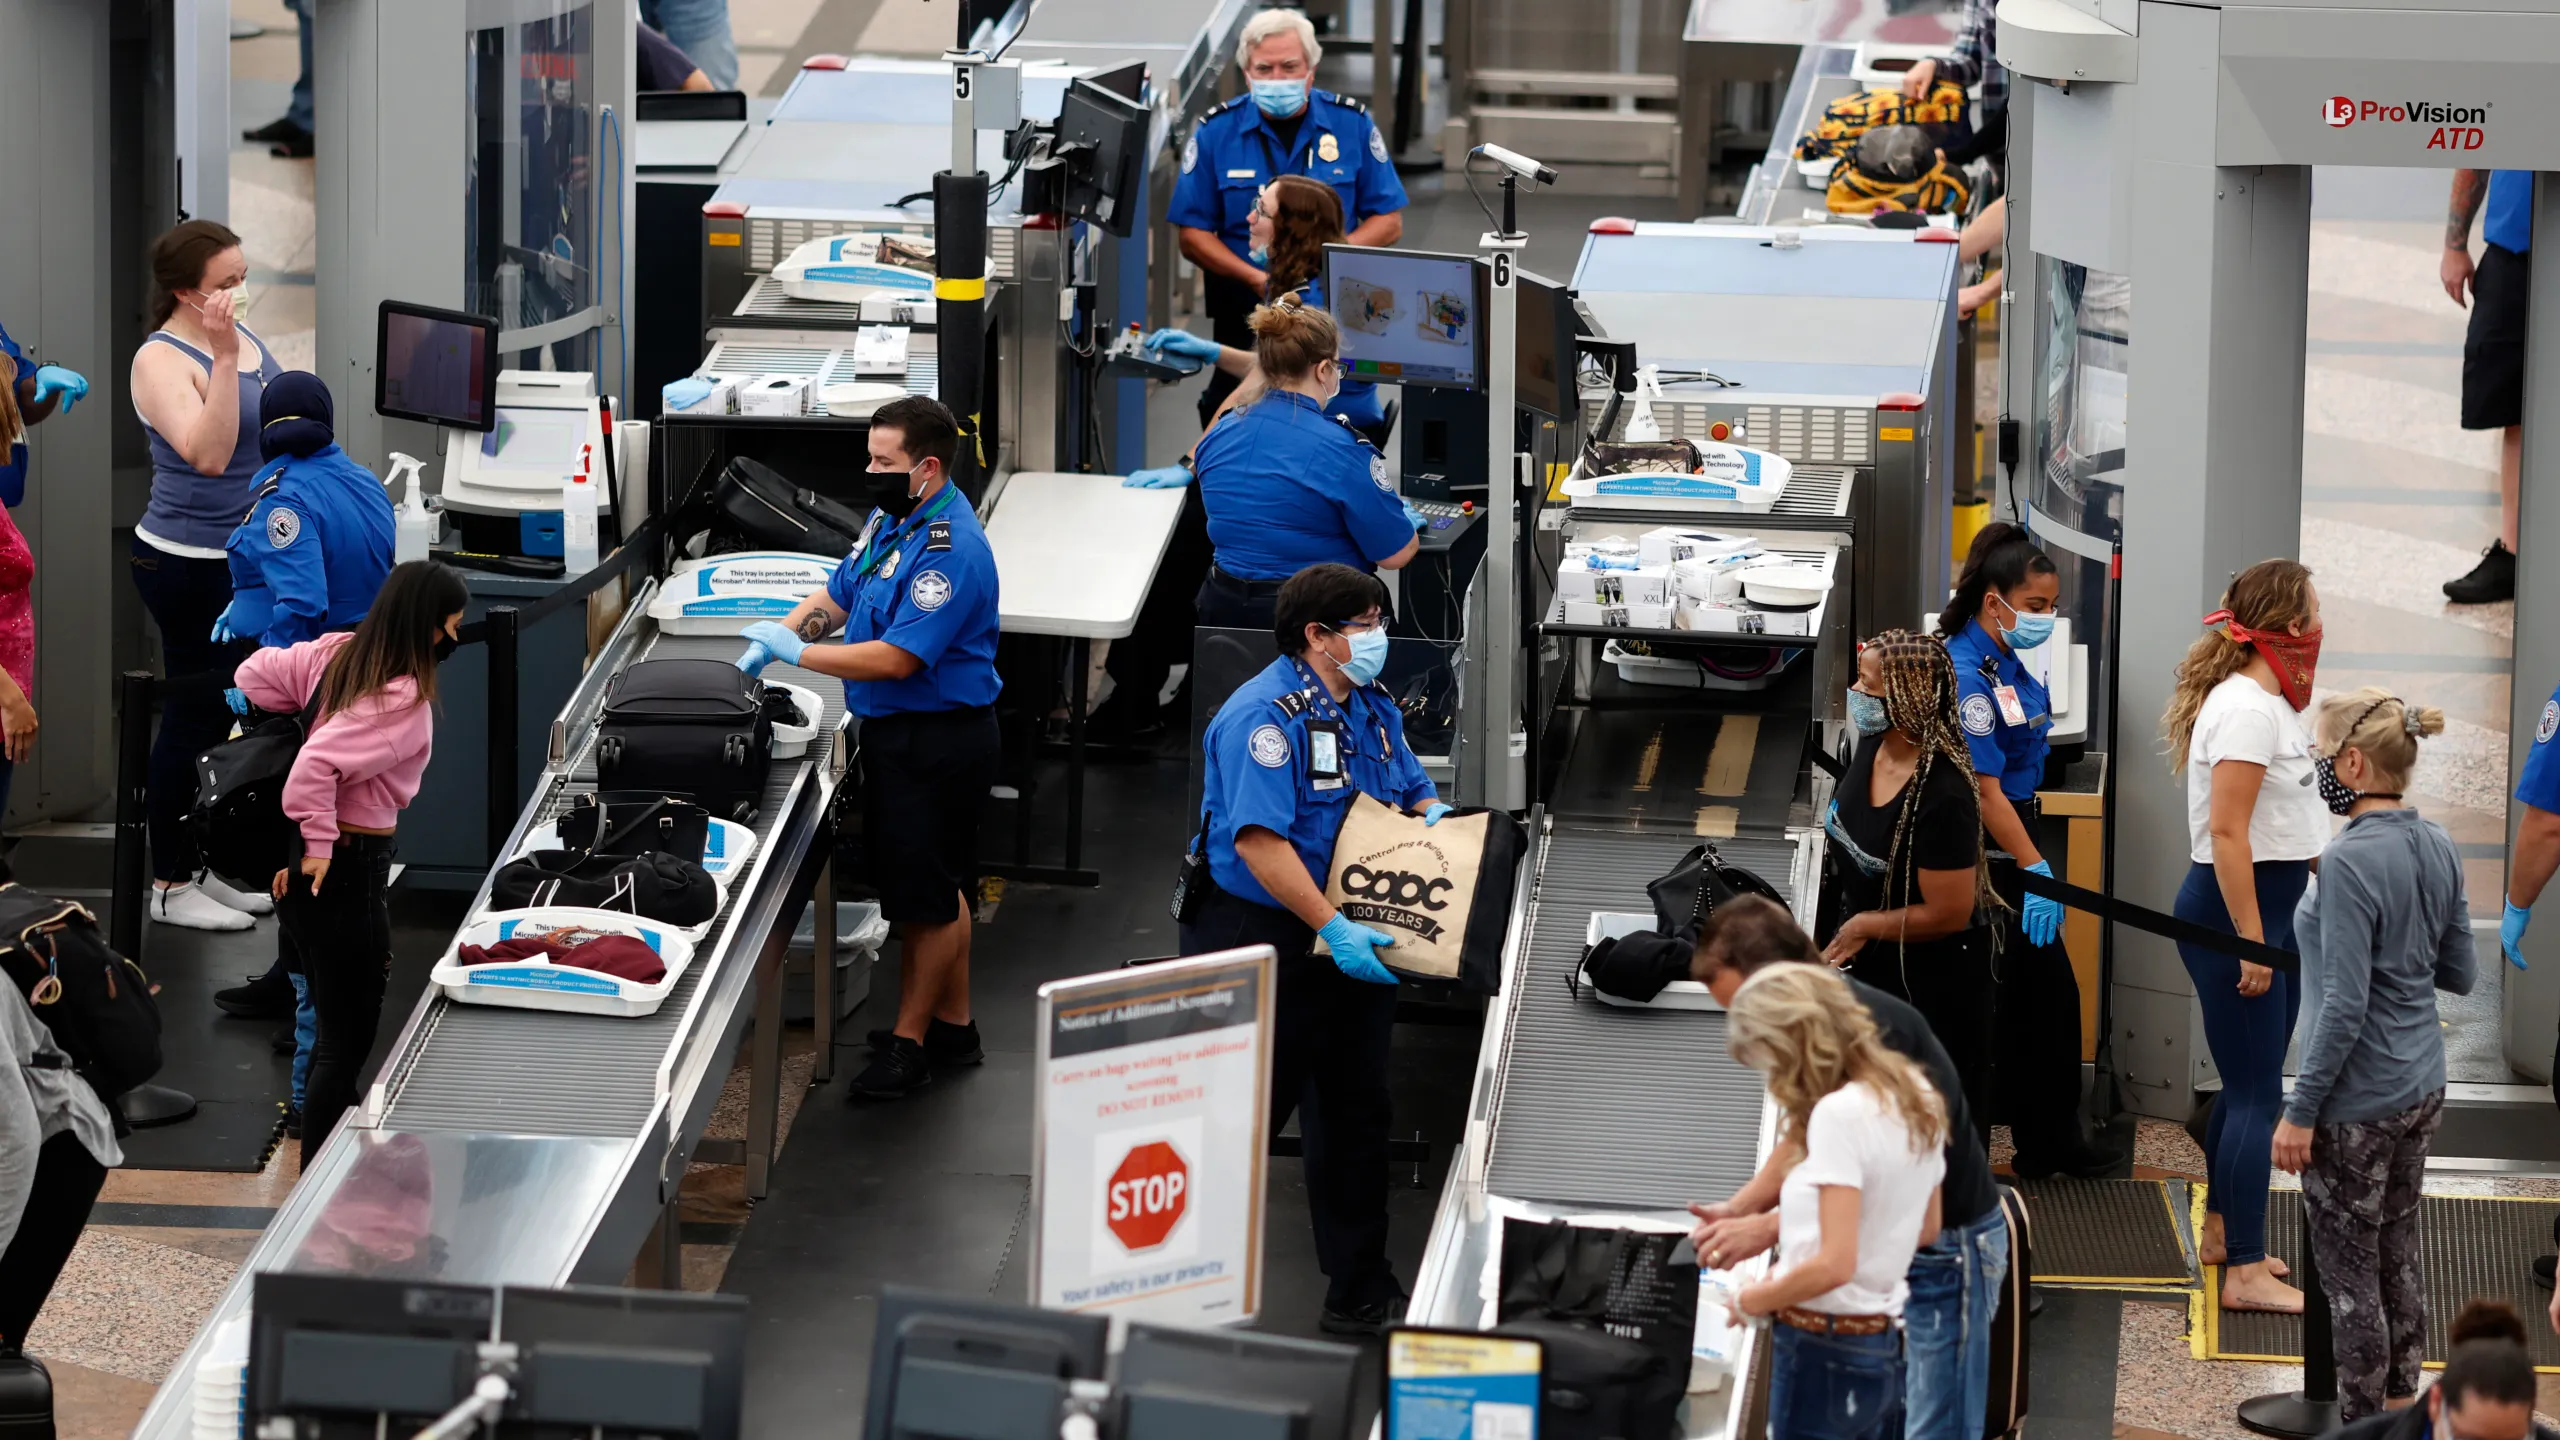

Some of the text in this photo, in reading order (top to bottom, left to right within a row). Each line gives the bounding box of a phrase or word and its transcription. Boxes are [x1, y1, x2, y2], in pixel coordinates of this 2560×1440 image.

[956, 68, 970, 99] 5
[2427, 127, 2485, 150] ATD
[1495, 254, 1509, 287] 6
[1706, 460, 1744, 469] Technology
[930, 530, 949, 538] TSA
[744, 570, 758, 578] tray
[765, 570, 796, 579] protected
[1643, 593, 1662, 604] XXL
[1286, 694, 1300, 711] TSA
[1359, 846, 1395, 864] Central
[1424, 841, 1444, 861] Burlap
[534, 923, 550, 932] This
[1352, 905, 1424, 930] 100 YEARS
[1058, 989, 1234, 1032] Notice of Additional Screening
[1132, 1052, 1173, 1071] waiting
[1195, 1039, 1250, 1060] additional
[1125, 1073, 1179, 1092] screening
[1097, 1086, 1205, 1118] DO NOT REMOVE
[1110, 1171, 1185, 1221] STOP
[1062, 1260, 1225, 1304] Your safety is our priority
[1604, 1322, 1642, 1339] THIS
